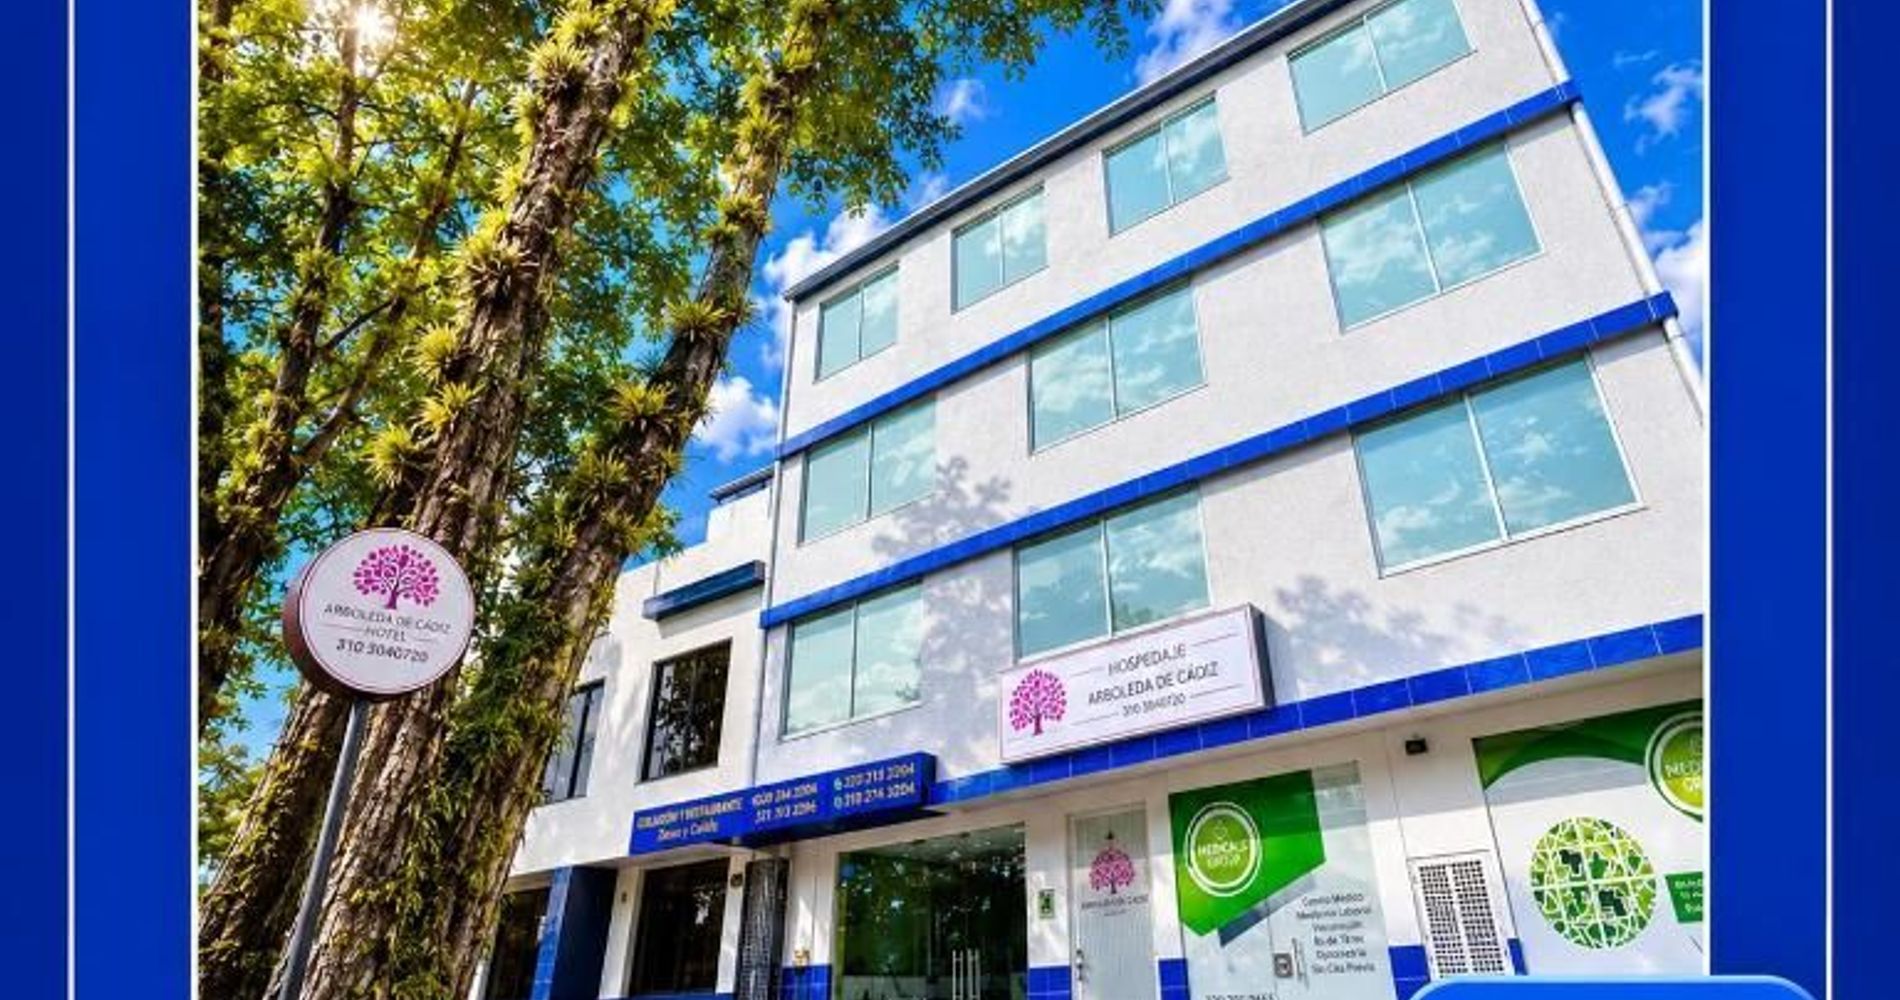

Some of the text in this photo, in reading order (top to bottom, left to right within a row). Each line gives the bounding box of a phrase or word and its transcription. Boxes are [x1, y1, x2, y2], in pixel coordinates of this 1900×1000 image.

[324, 604, 393, 624] ARBOLEDA
[396, 616, 412, 629] DE
[365, 626, 406, 642] HOTEL
[336, 638, 429, 663] 310 3040720
[1108, 643, 1186, 676] HOSPEDAJE
[1088, 678, 1154, 705] ARBOLEDA
[1155, 673, 1175, 690] DE
